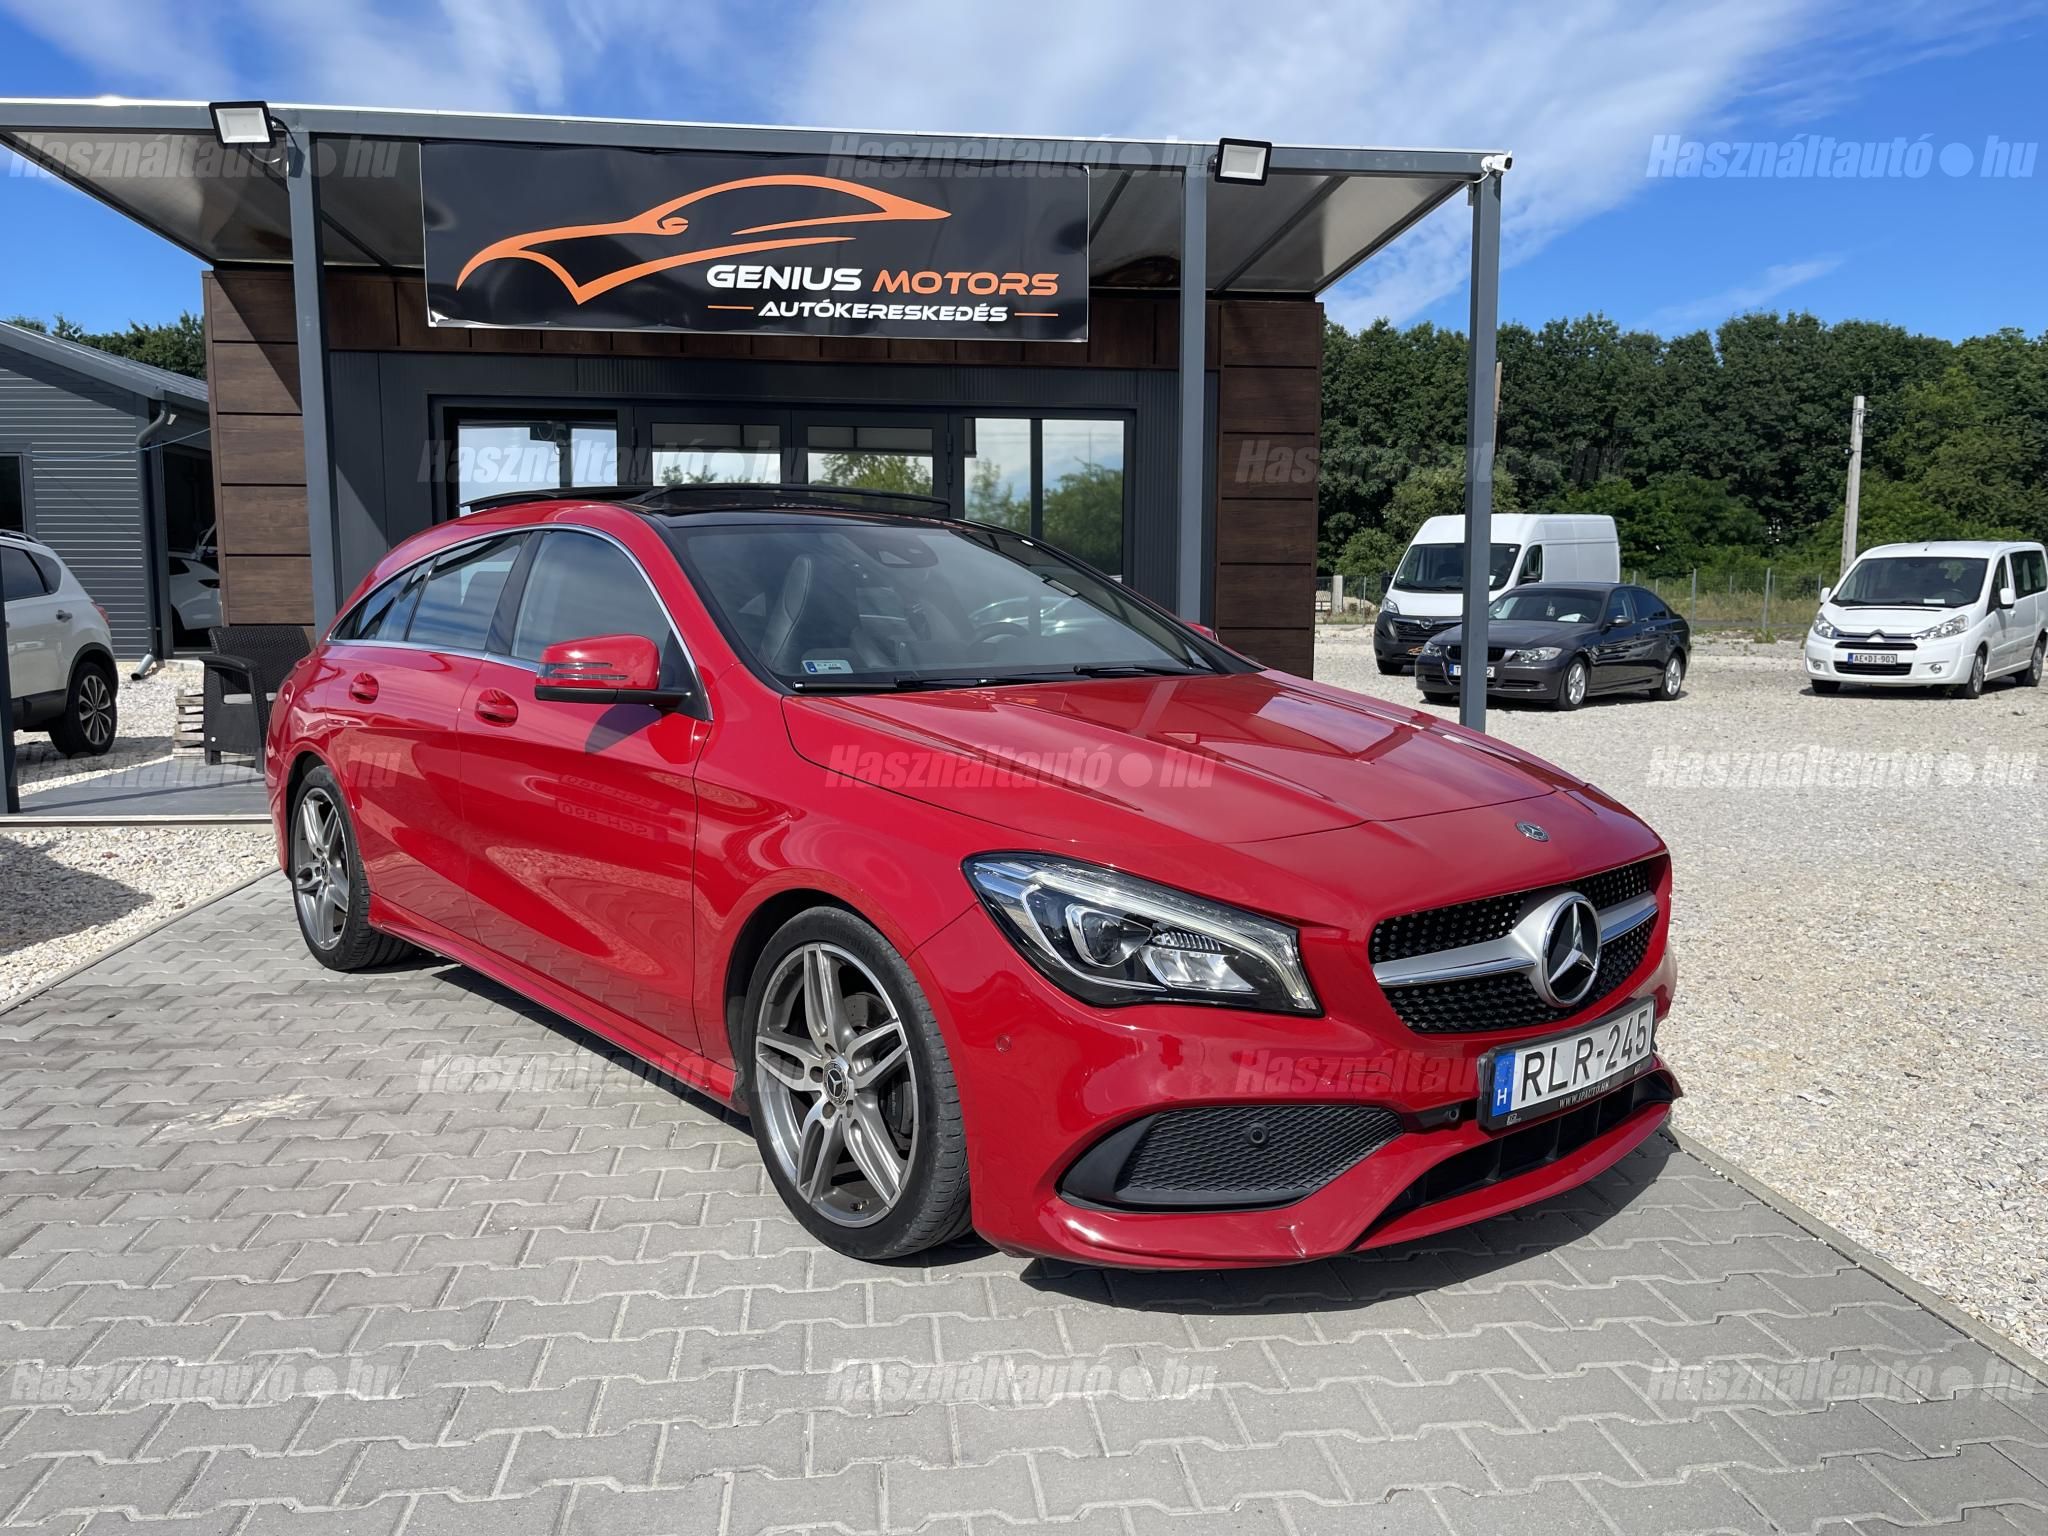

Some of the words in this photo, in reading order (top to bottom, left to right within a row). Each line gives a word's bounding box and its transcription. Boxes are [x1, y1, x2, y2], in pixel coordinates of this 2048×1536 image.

[706, 265, 863, 291] GENIUS
[872, 269, 1060, 296] MOTORS
[758, 299, 1008, 322] AUTÓKERESKEDÉS
[1521, 1009, 1648, 1103] RLR-245
[1496, 1088, 1508, 1106] H
